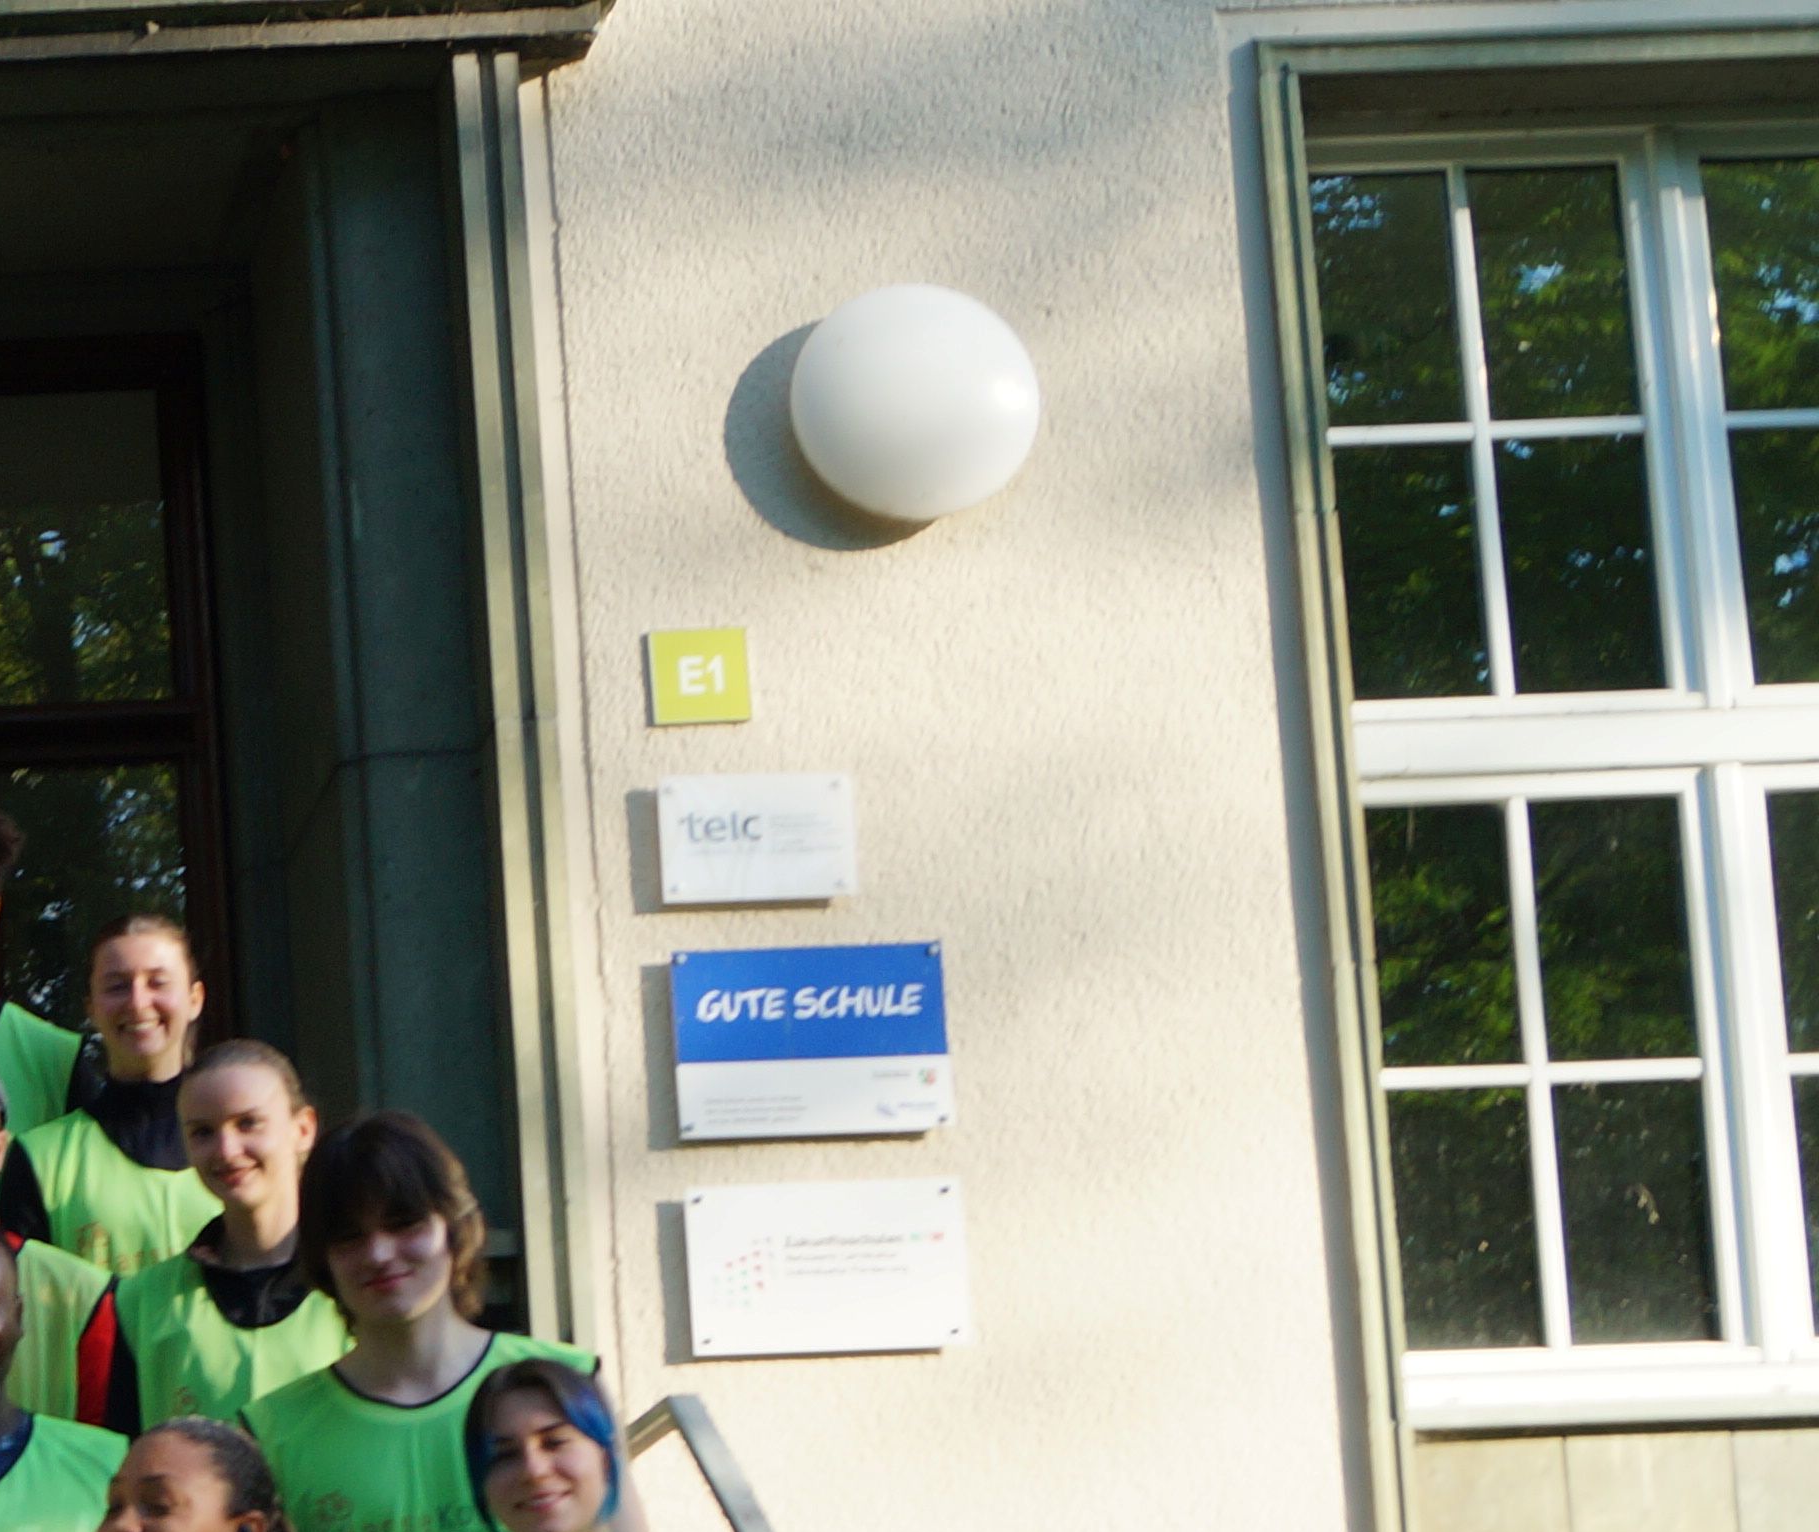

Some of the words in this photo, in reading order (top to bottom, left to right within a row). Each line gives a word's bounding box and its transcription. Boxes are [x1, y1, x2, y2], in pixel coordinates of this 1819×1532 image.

[677, 654, 726, 697] E1
[679, 811, 763, 843] telc
[696, 987, 788, 1023] GUTE
[793, 983, 925, 1020] SCHULE
